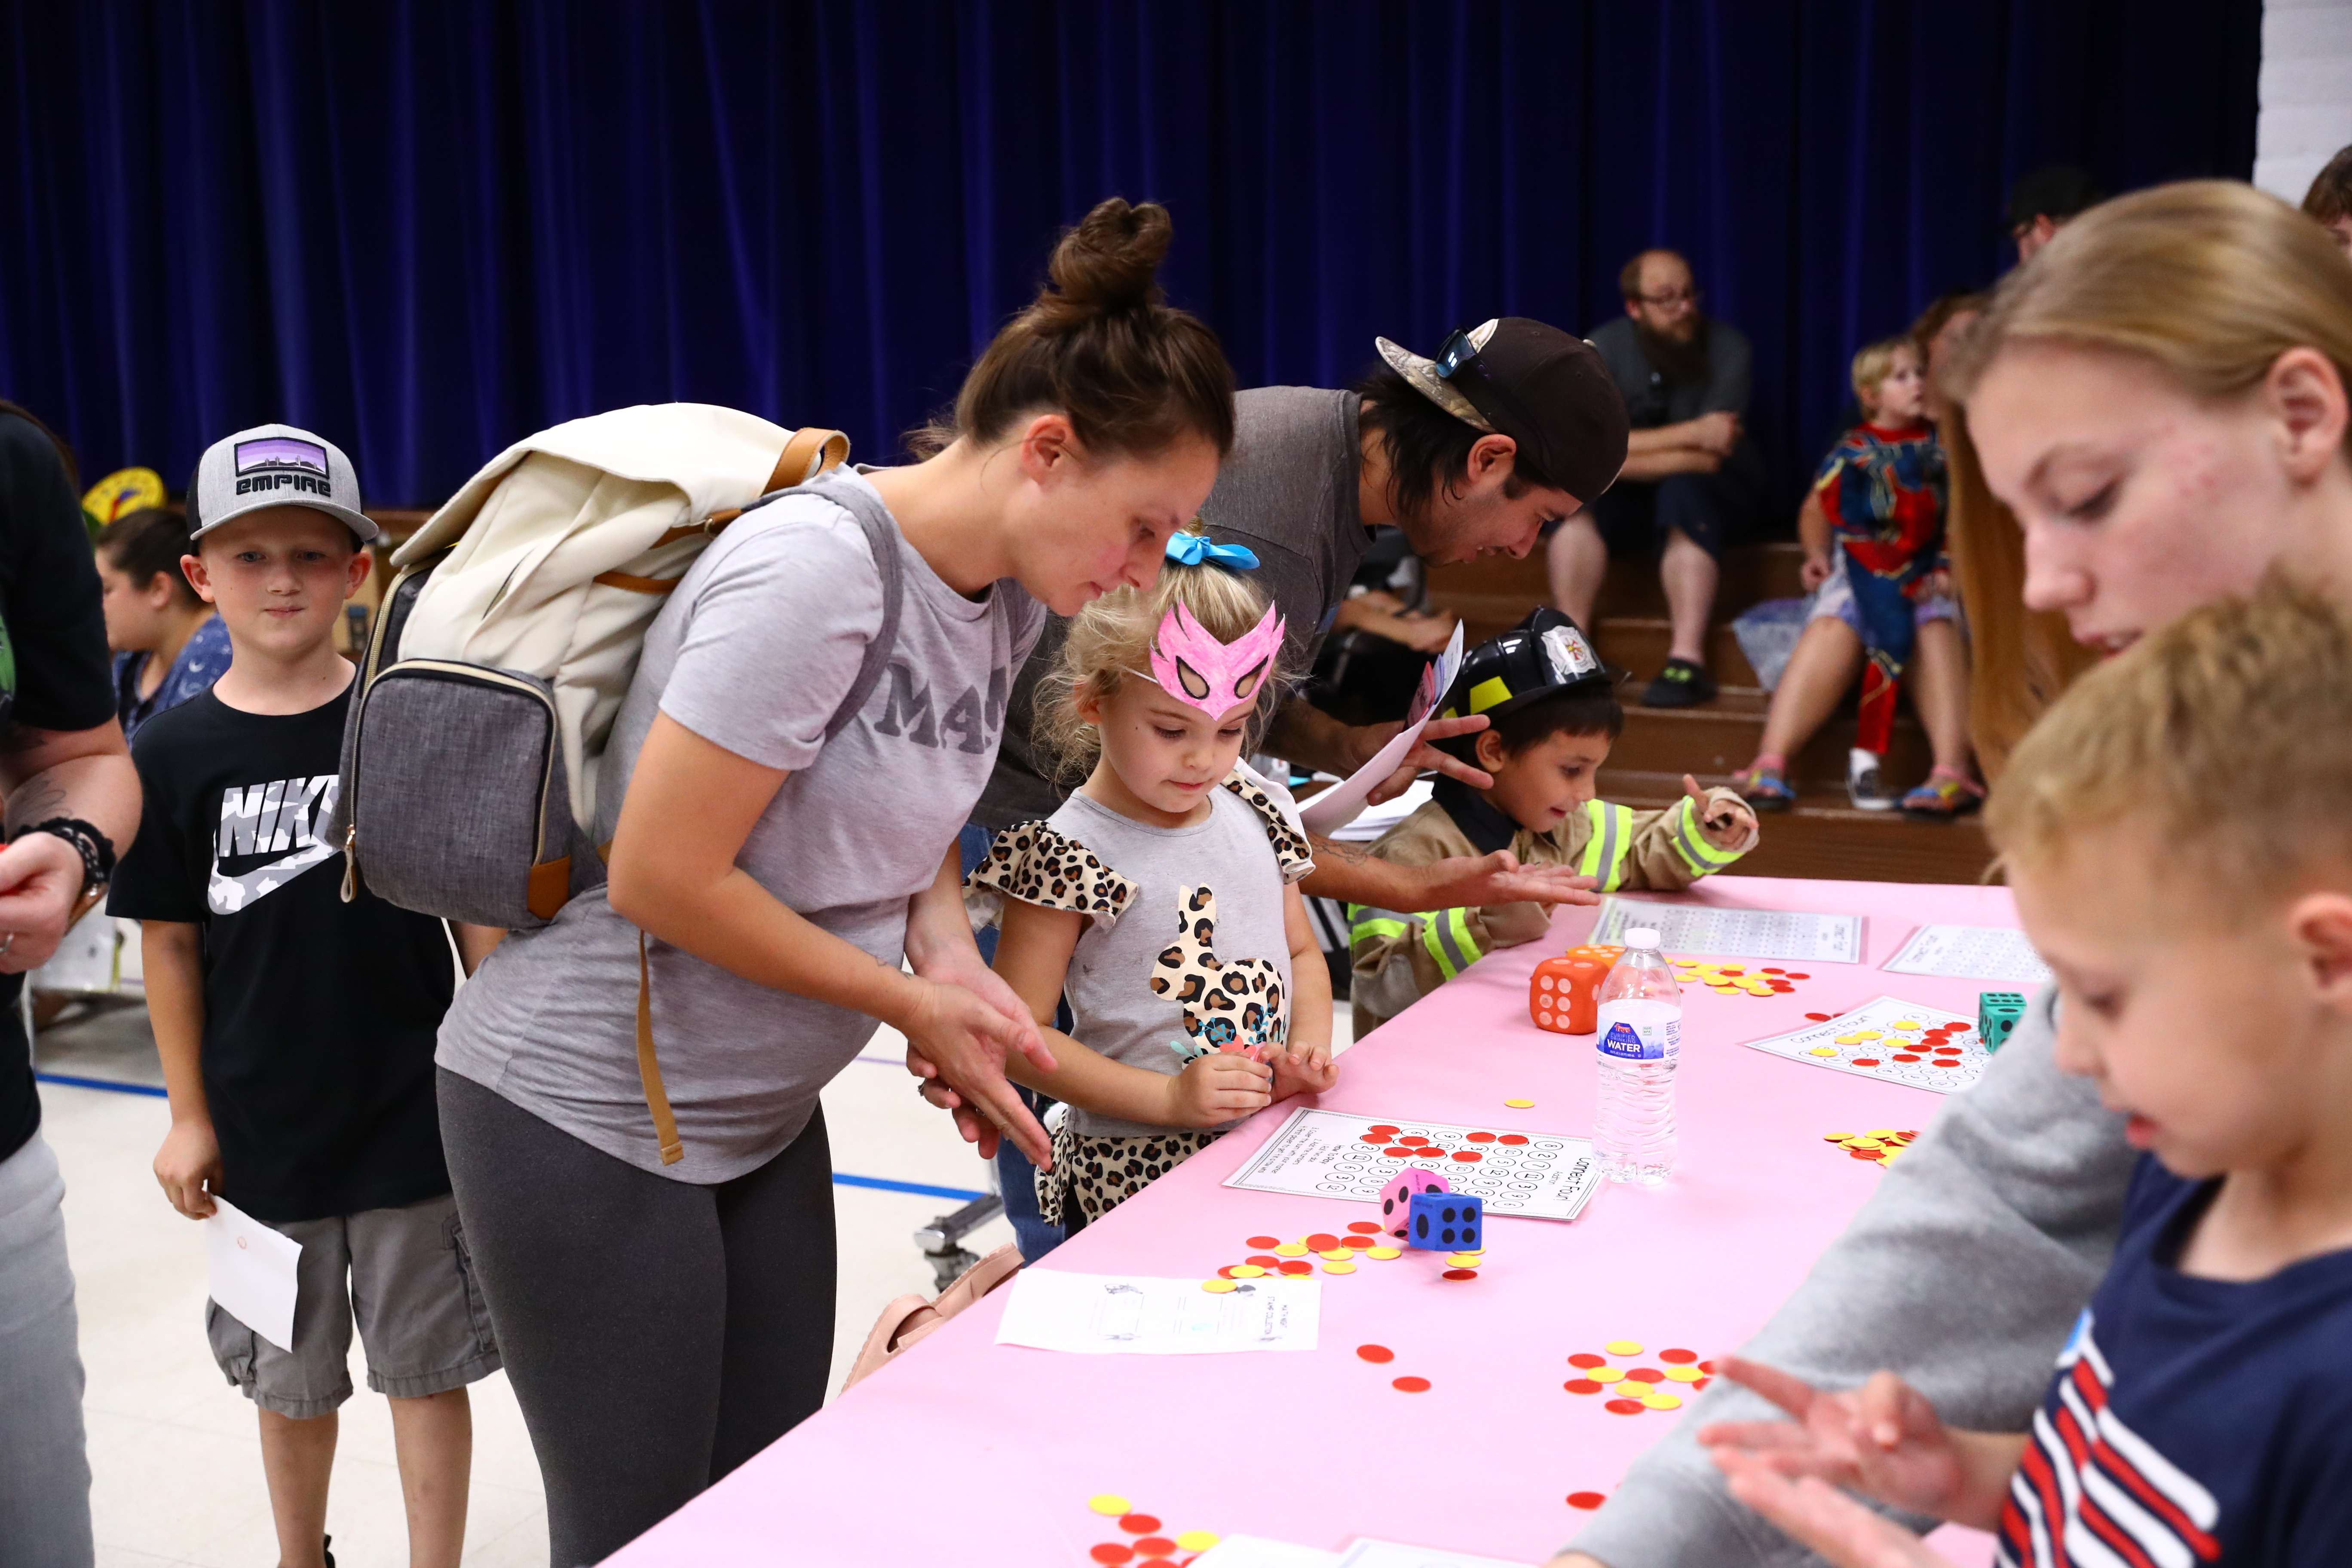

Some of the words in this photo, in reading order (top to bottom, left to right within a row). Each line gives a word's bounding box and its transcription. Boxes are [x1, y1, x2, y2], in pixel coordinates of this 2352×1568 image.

[236, 475, 331, 497] EMPIRE
[1607, 1038, 1640, 1052] WATER
[1286, 1135, 1296, 1143] player
[1288, 1149, 1297, 1158] with
[1548, 1170, 1563, 1185] Addition
[1565, 1157, 1592, 1185] Connect
[1553, 1185, 1580, 1201] Four!
